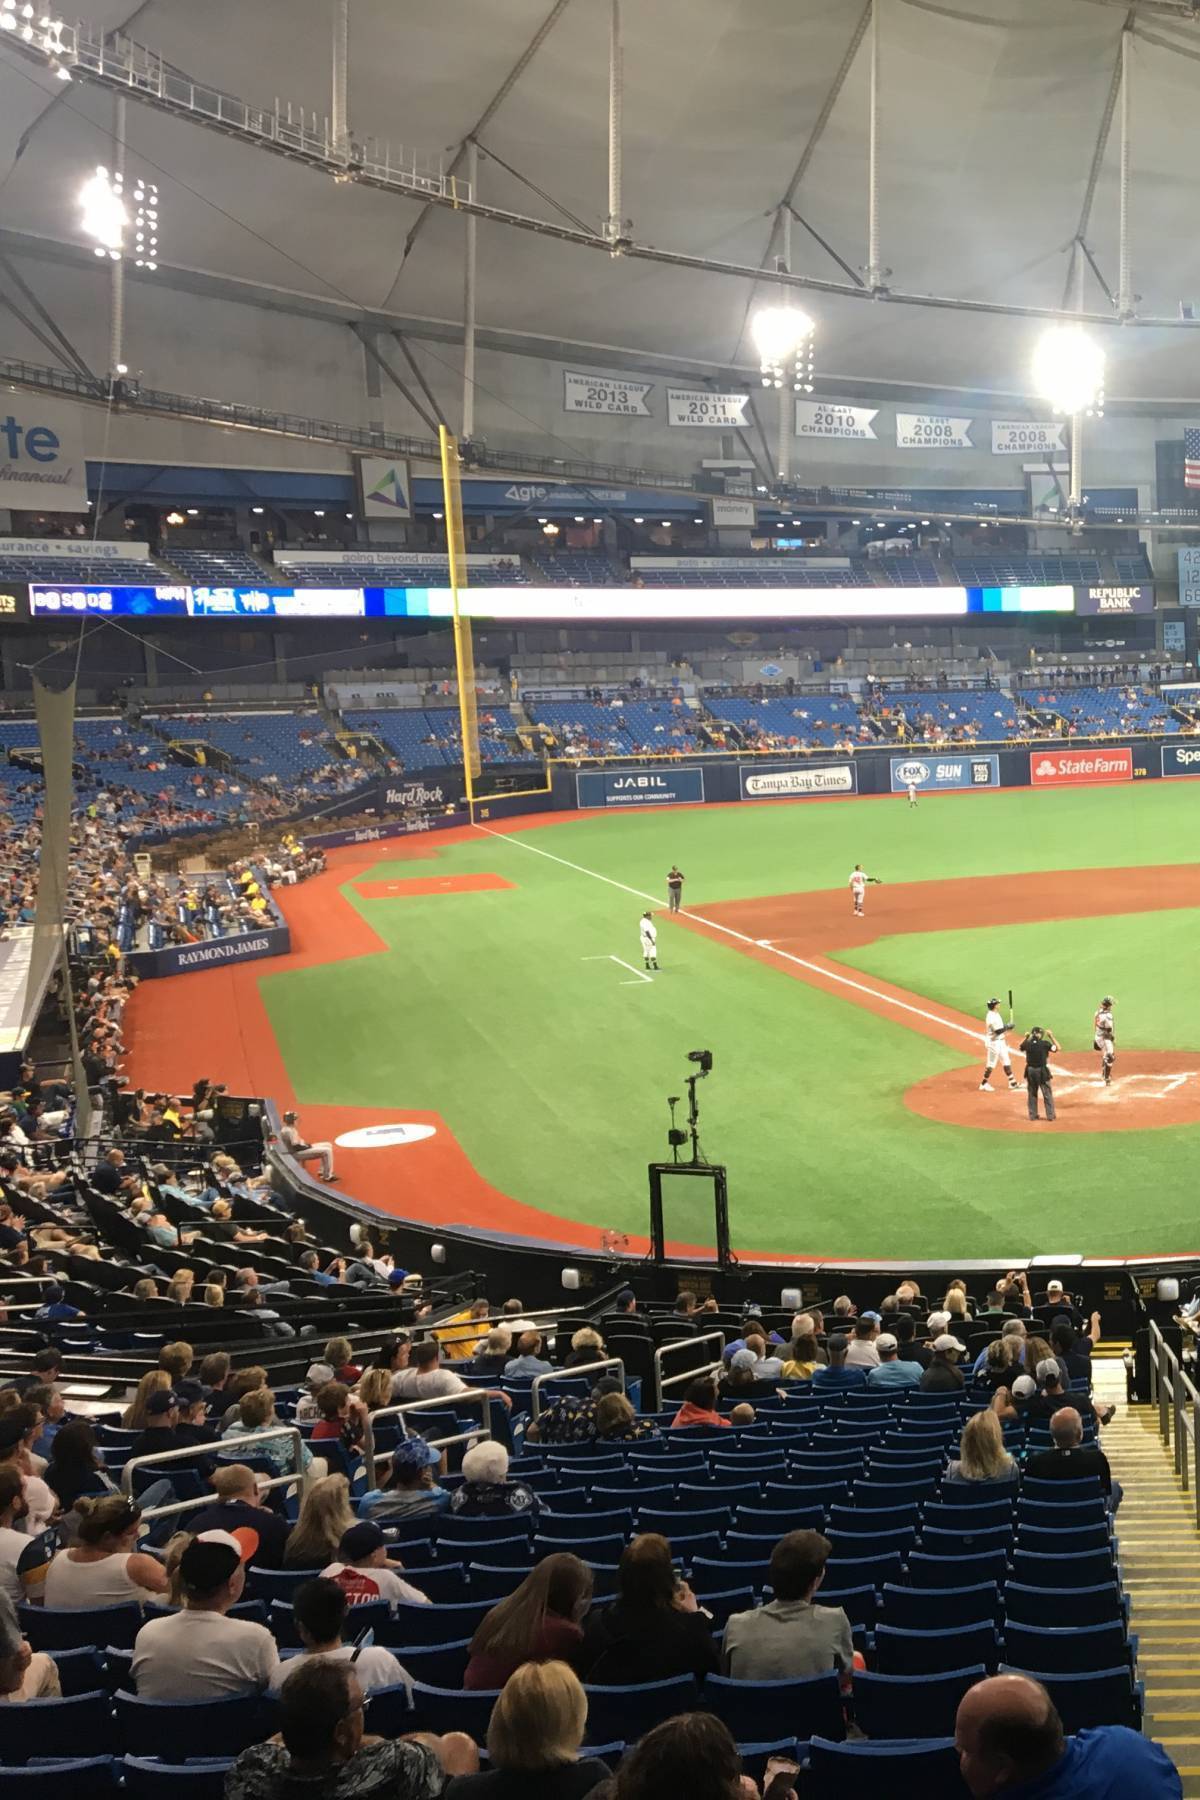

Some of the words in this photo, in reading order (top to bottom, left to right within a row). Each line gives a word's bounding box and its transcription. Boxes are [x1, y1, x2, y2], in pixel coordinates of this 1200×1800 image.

[587, 387, 628, 404] 2013
[574, 400, 602, 410] WILD
[607, 404, 637, 413] CARD
[688, 402, 728, 415] 2011
[677, 415, 704, 423] WILD
[708, 416, 737, 425] CARD
[814, 413, 855, 427] 2010
[801, 425, 866, 437] CHAMPIONS
[914, 424, 953, 437] 2008
[1009, 431, 1047, 442] 2008
[902, 436, 963, 447] CHAMPIONS
[997, 443, 1057, 451] CHAMPIONS
[67, 544, 118, 556] savings
[342, 553, 376, 564] going
[377, 553, 418, 564] beyond
[1184, 551, 1200, 564] 42
[1186, 570, 1200, 583] 12
[1089, 587, 1141, 599] REPUBLIC
[1100, 598, 1131, 608] BANK
[903, 767, 921, 775] FOX
[936, 764, 962, 778] SUN
[613, 776, 667, 789] JABIL
[751, 777, 789, 793] Tampa
[791, 776, 814, 791] Bay
[813, 773, 848, 787] Times
[386, 787, 415, 805] Hard
[416, 785, 443, 802] Rock
[178, 948, 234, 966] RAYMOND
[234, 938, 269, 955] JAMES
